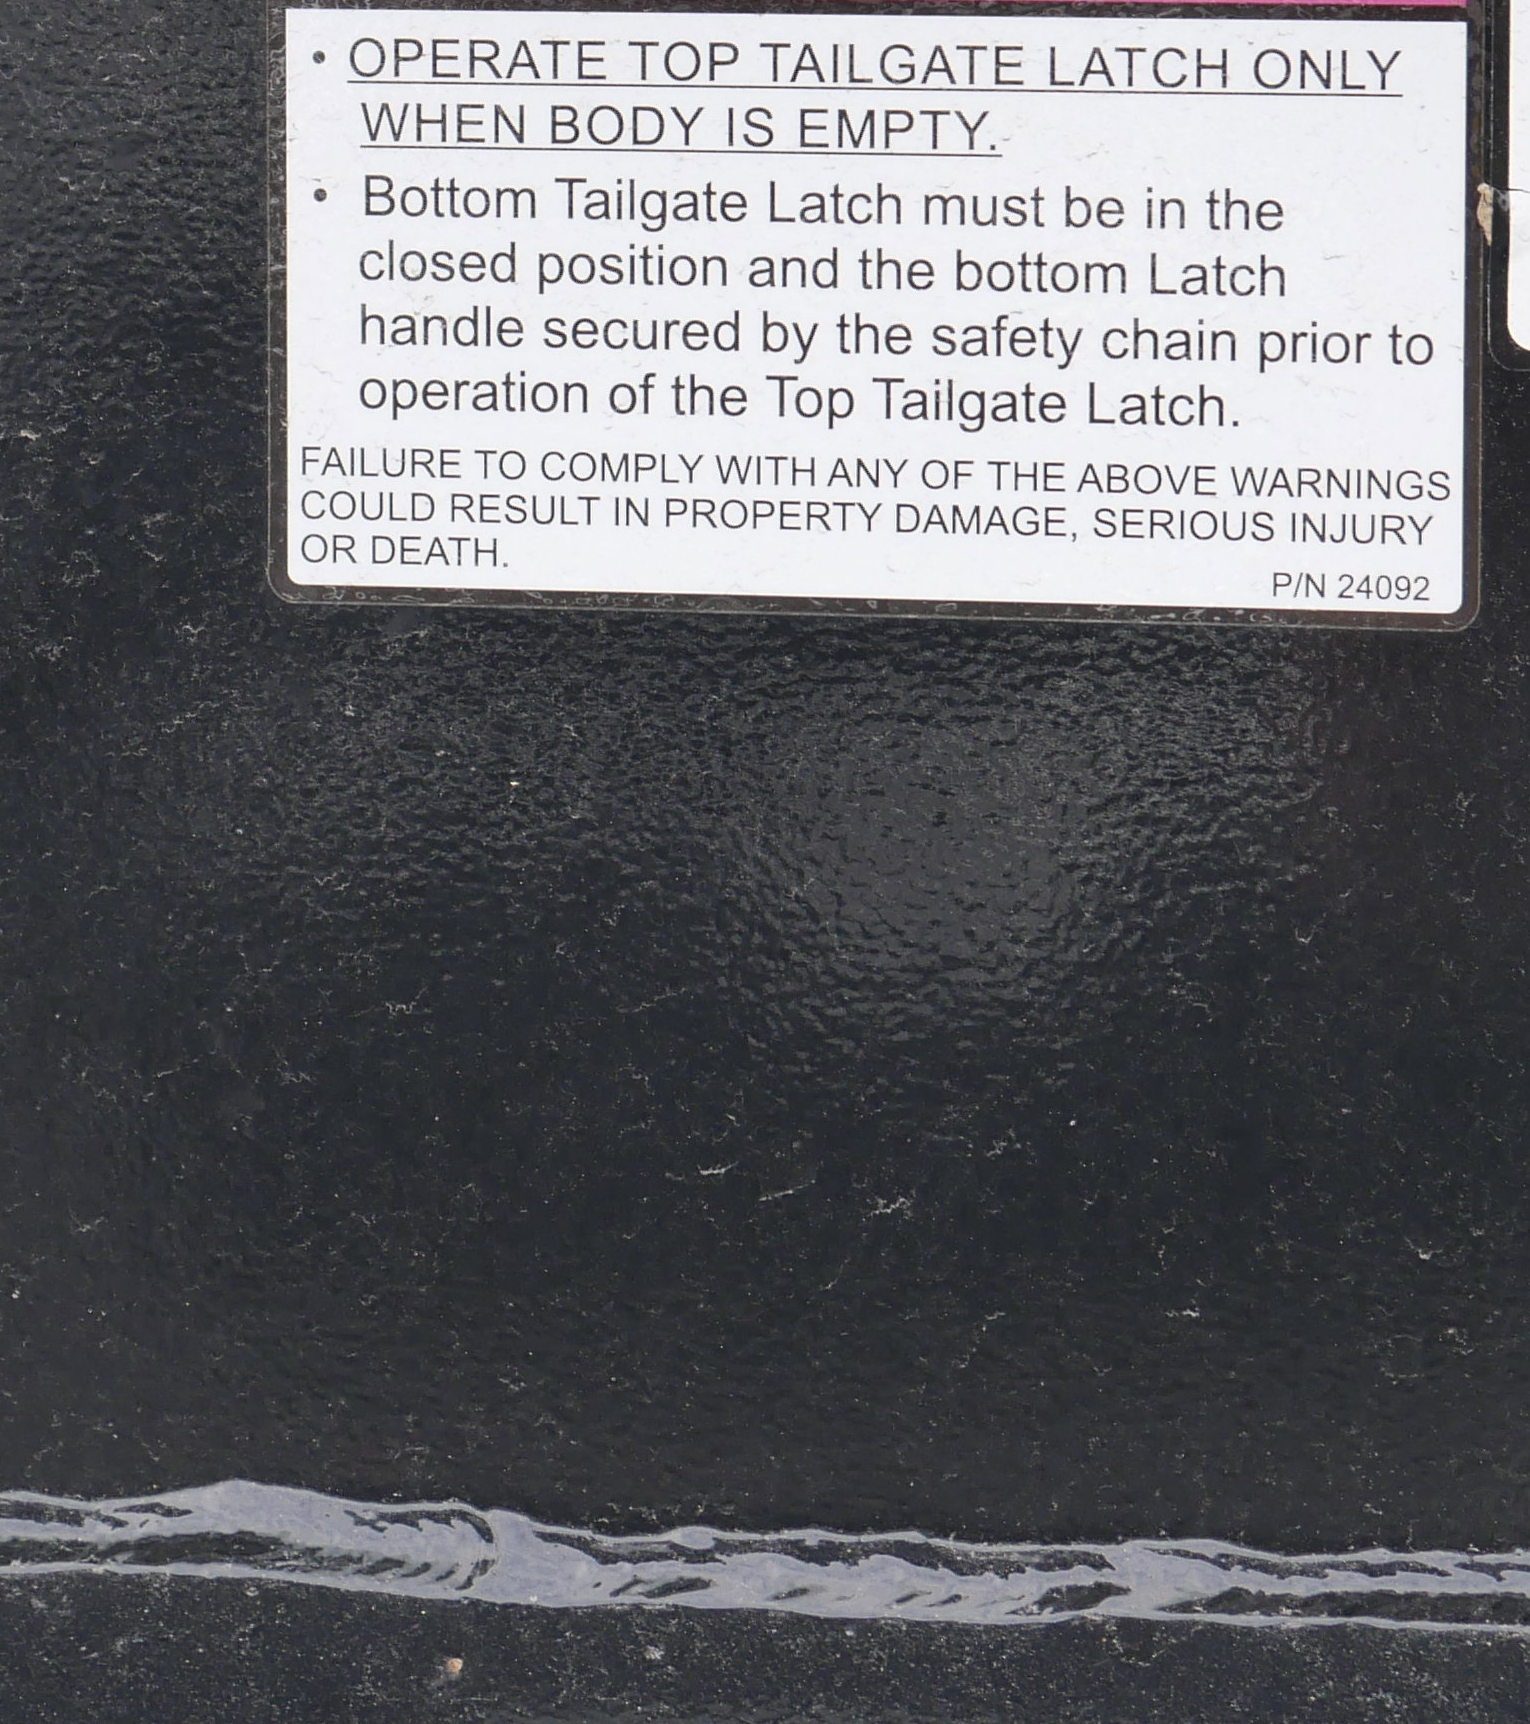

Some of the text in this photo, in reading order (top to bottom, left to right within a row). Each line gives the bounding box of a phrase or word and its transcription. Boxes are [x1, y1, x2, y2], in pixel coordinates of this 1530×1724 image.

[350, 38, 1401, 90] OPERATE TOP TAILGATE LATCH ONLY
[361, 103, 1000, 150] WHEN BODY IS EMPTY.
[365, 175, 1283, 232] Bottom Tailgate Latch must be in the
[360, 240, 1285, 296] closed position and the bottom Latch
[361, 304, 1433, 373] handle secured by the safety chain prior to
[360, 370, 1238, 433] operation of the Top Tailgate Latch.
[302, 447, 1450, 501] FAILURE TO COMPLY WITH ANY OF THE ABOVE WARNINGS
[301, 490, 1433, 545] COULD RESULT IN PROPERTY DAMAGE, SERIOUS INJURY
[301, 534, 508, 567] OR DEATH.
[1273, 572, 1429, 601] P/N 24092
